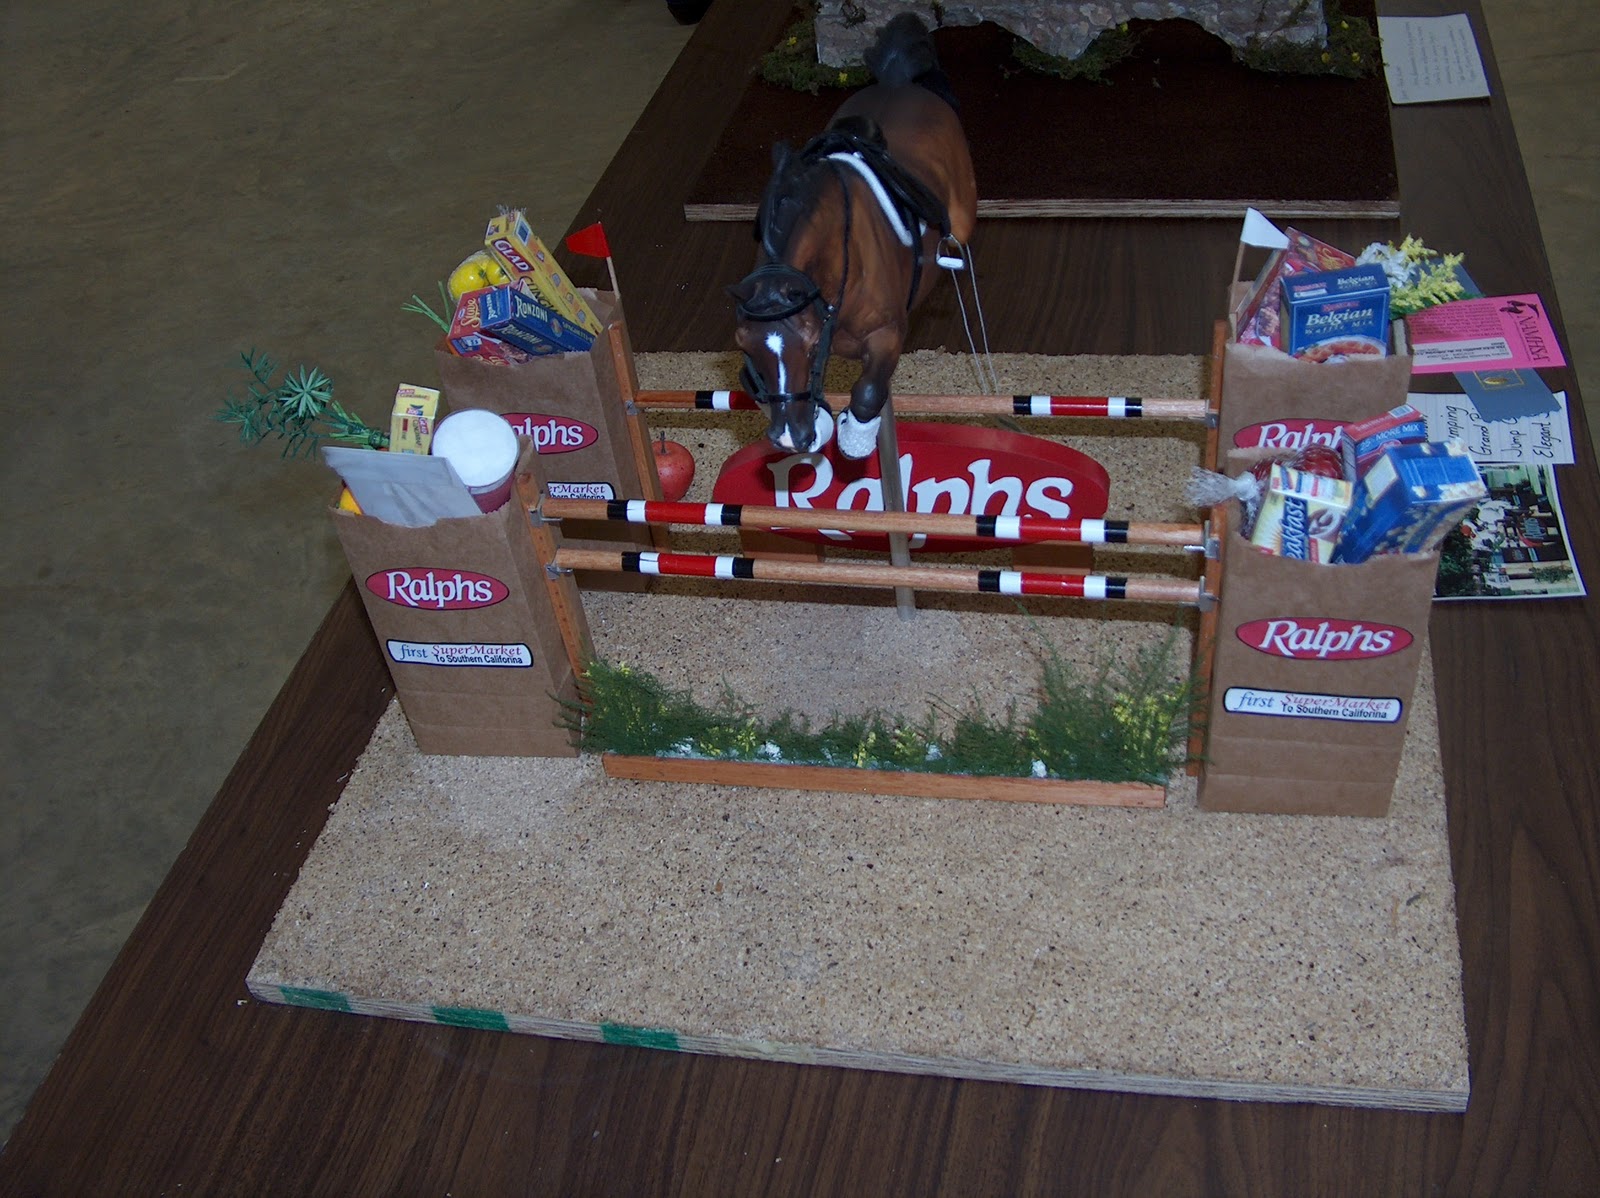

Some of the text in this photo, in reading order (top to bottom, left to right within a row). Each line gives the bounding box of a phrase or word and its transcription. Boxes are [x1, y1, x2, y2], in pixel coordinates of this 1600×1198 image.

[493, 238, 531, 271] GLAD
[514, 295, 549, 322] RONZONI
[1306, 308, 1373, 326] Belgian
[1258, 422, 1344, 450] Ralph
[1402, 424, 1420, 433] MIX
[1469, 426, 1492, 456] Grand
[1532, 422, 1561, 459] Elegant
[1501, 430, 1528, 458] Jump
[386, 571, 493, 608] Ralphs
[400, 644, 522, 660] first SuperMarket
[1258, 620, 1394, 658] Ralphs
[434, 655, 446, 663] To
[447, 655, 483, 664] Southern
[1236, 692, 1393, 711] first SuperMarket
[1281, 703, 1294, 713] To
[1296, 705, 1340, 716] Southern
